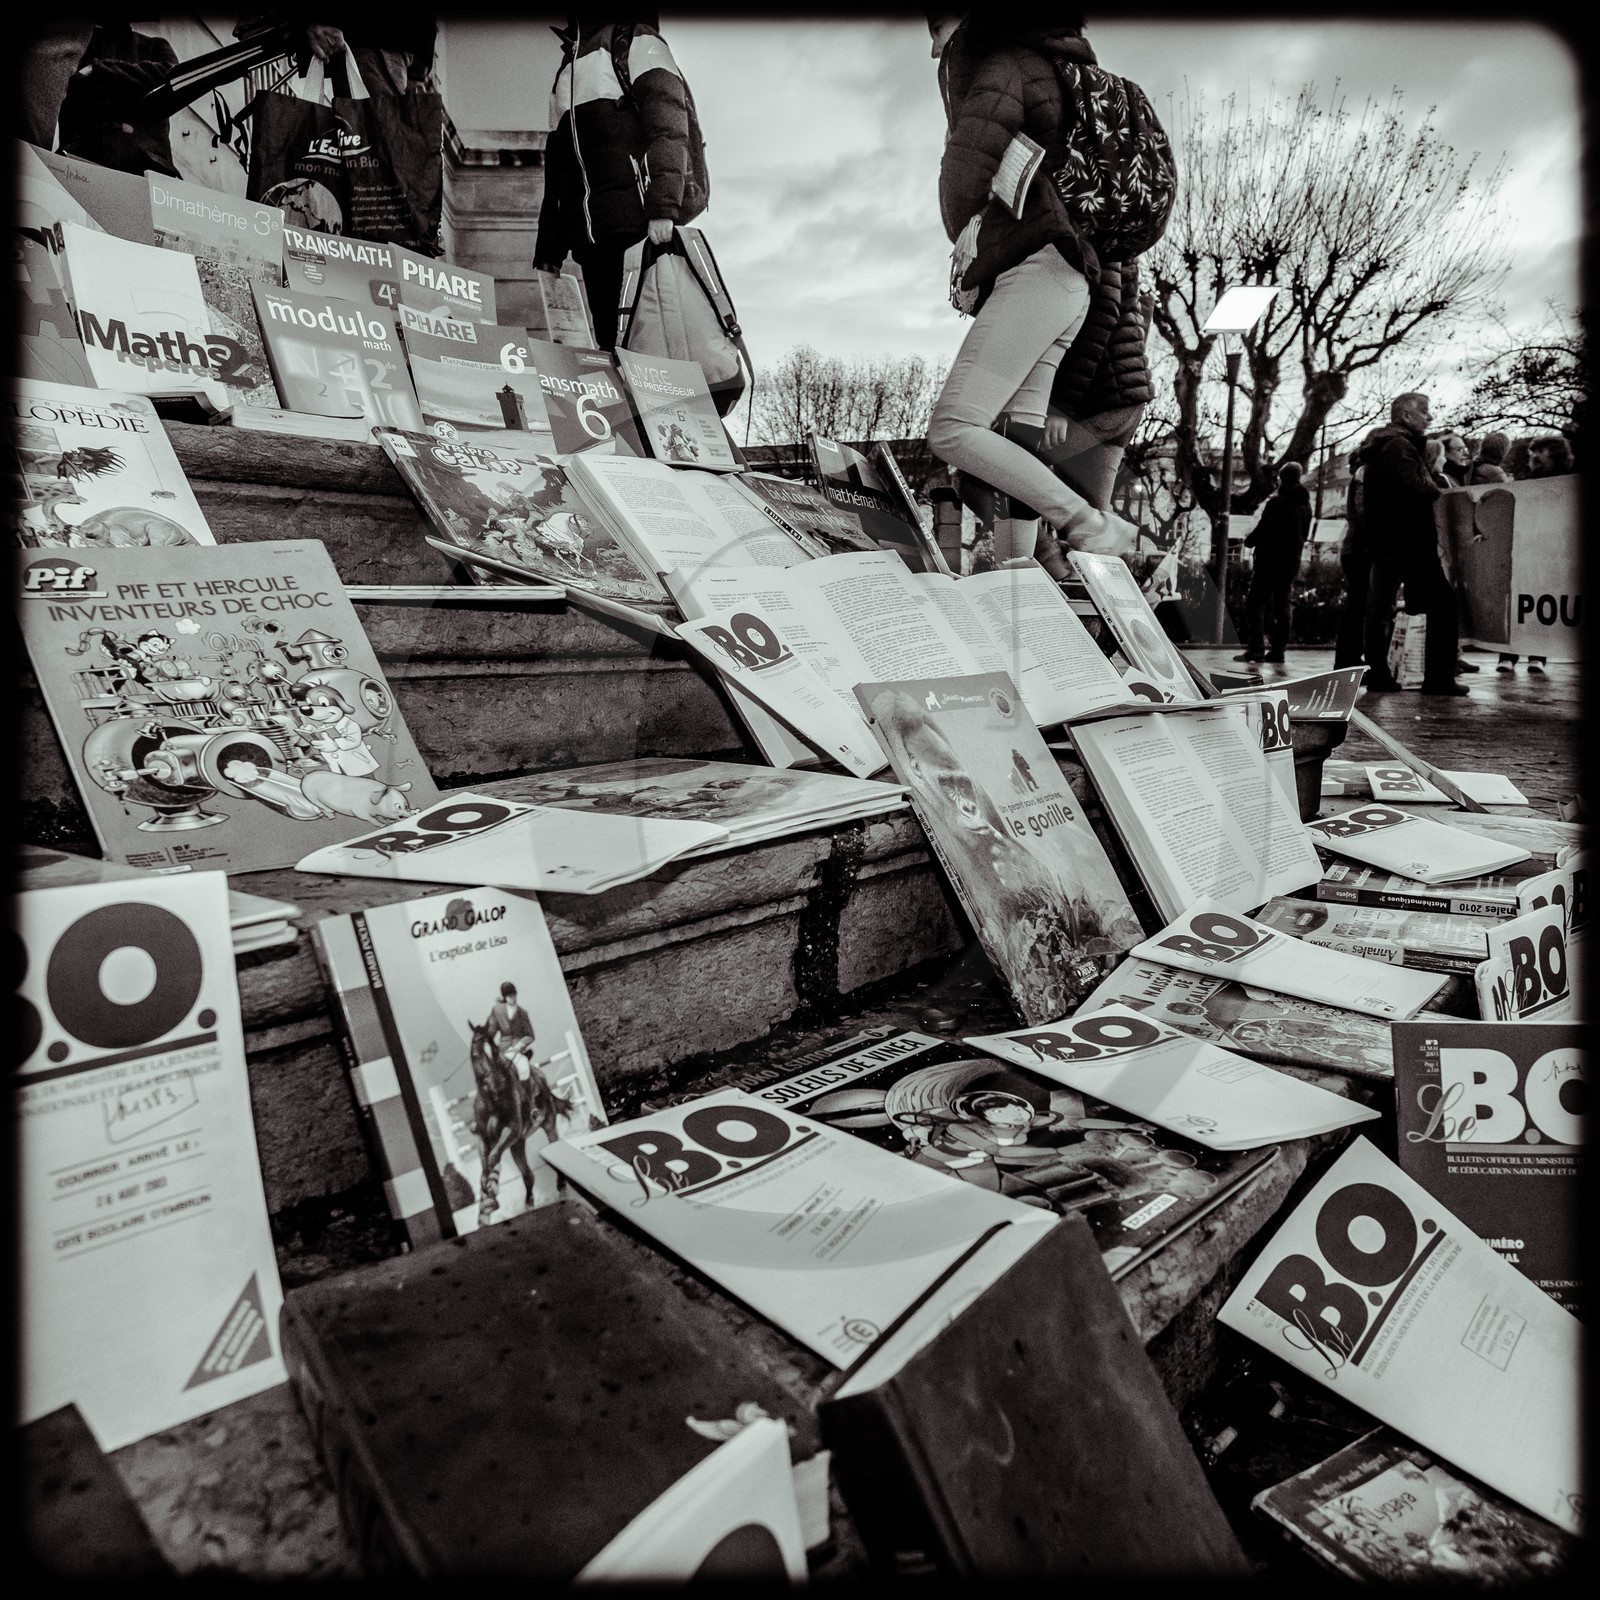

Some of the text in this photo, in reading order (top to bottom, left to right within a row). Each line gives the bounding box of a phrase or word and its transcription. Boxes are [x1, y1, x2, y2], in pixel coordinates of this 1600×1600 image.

[360, 155, 380, 168] Bio
[152, 186, 248, 230] Dimathème
[283, 228, 393, 268] TRANSMATH
[402, 258, 482, 303] PHARE
[266, 298, 387, 341] modulo
[403, 311, 476, 342] PHARE
[79, 309, 223, 370] Maths
[363, 339, 392, 352] math
[500, 342, 528, 374] 6e
[626, 361, 673, 386] LIVRE
[632, 378, 697, 397] DU PROFESSEUR
[24, 566, 97, 590] Pif
[118, 576, 298, 600] PIF ET HERCULE
[49, 592, 334, 622] INVENTEURS DE CHOC
[699, 612, 790, 668] B.O.
[1000, 805, 1008, 814] Un
[1008, 800, 1024, 813] géant
[1006, 803, 1075, 838] le gorille
[342, 802, 528, 853] B.O.
[1336, 891, 1357, 900] Sujets
[1388, 896, 1447, 909] Mathématiques
[1460, 903, 1482, 914] 2010
[411, 905, 507, 939] GRAND GALOP
[430, 935, 508, 963] L'exploit de Lisa
[1157, 912, 1269, 962] B.O.
[1352, 945, 1397, 961] Annales
[1135, 969, 1155, 980] LA
[1174, 979, 1194, 989] DE
[1005, 1015, 1178, 1061] B.O.
[760, 1066, 846, 1104] SOLEILS
[842, 1055, 878, 1075] DE
[873, 1038, 927, 1065] VINÉA
[783, 1048, 831, 1074] tsuno
[596, 1105, 812, 1187] B.O.
[1486, 1156, 1523, 1165] OFFICIEL
[1524, 1156, 1535, 1165] DU
[1514, 1167, 1557, 1176] NATIONALE
[1557, 1167, 1567, 1176] ET
[1254, 1182, 1438, 1360] B.O.
